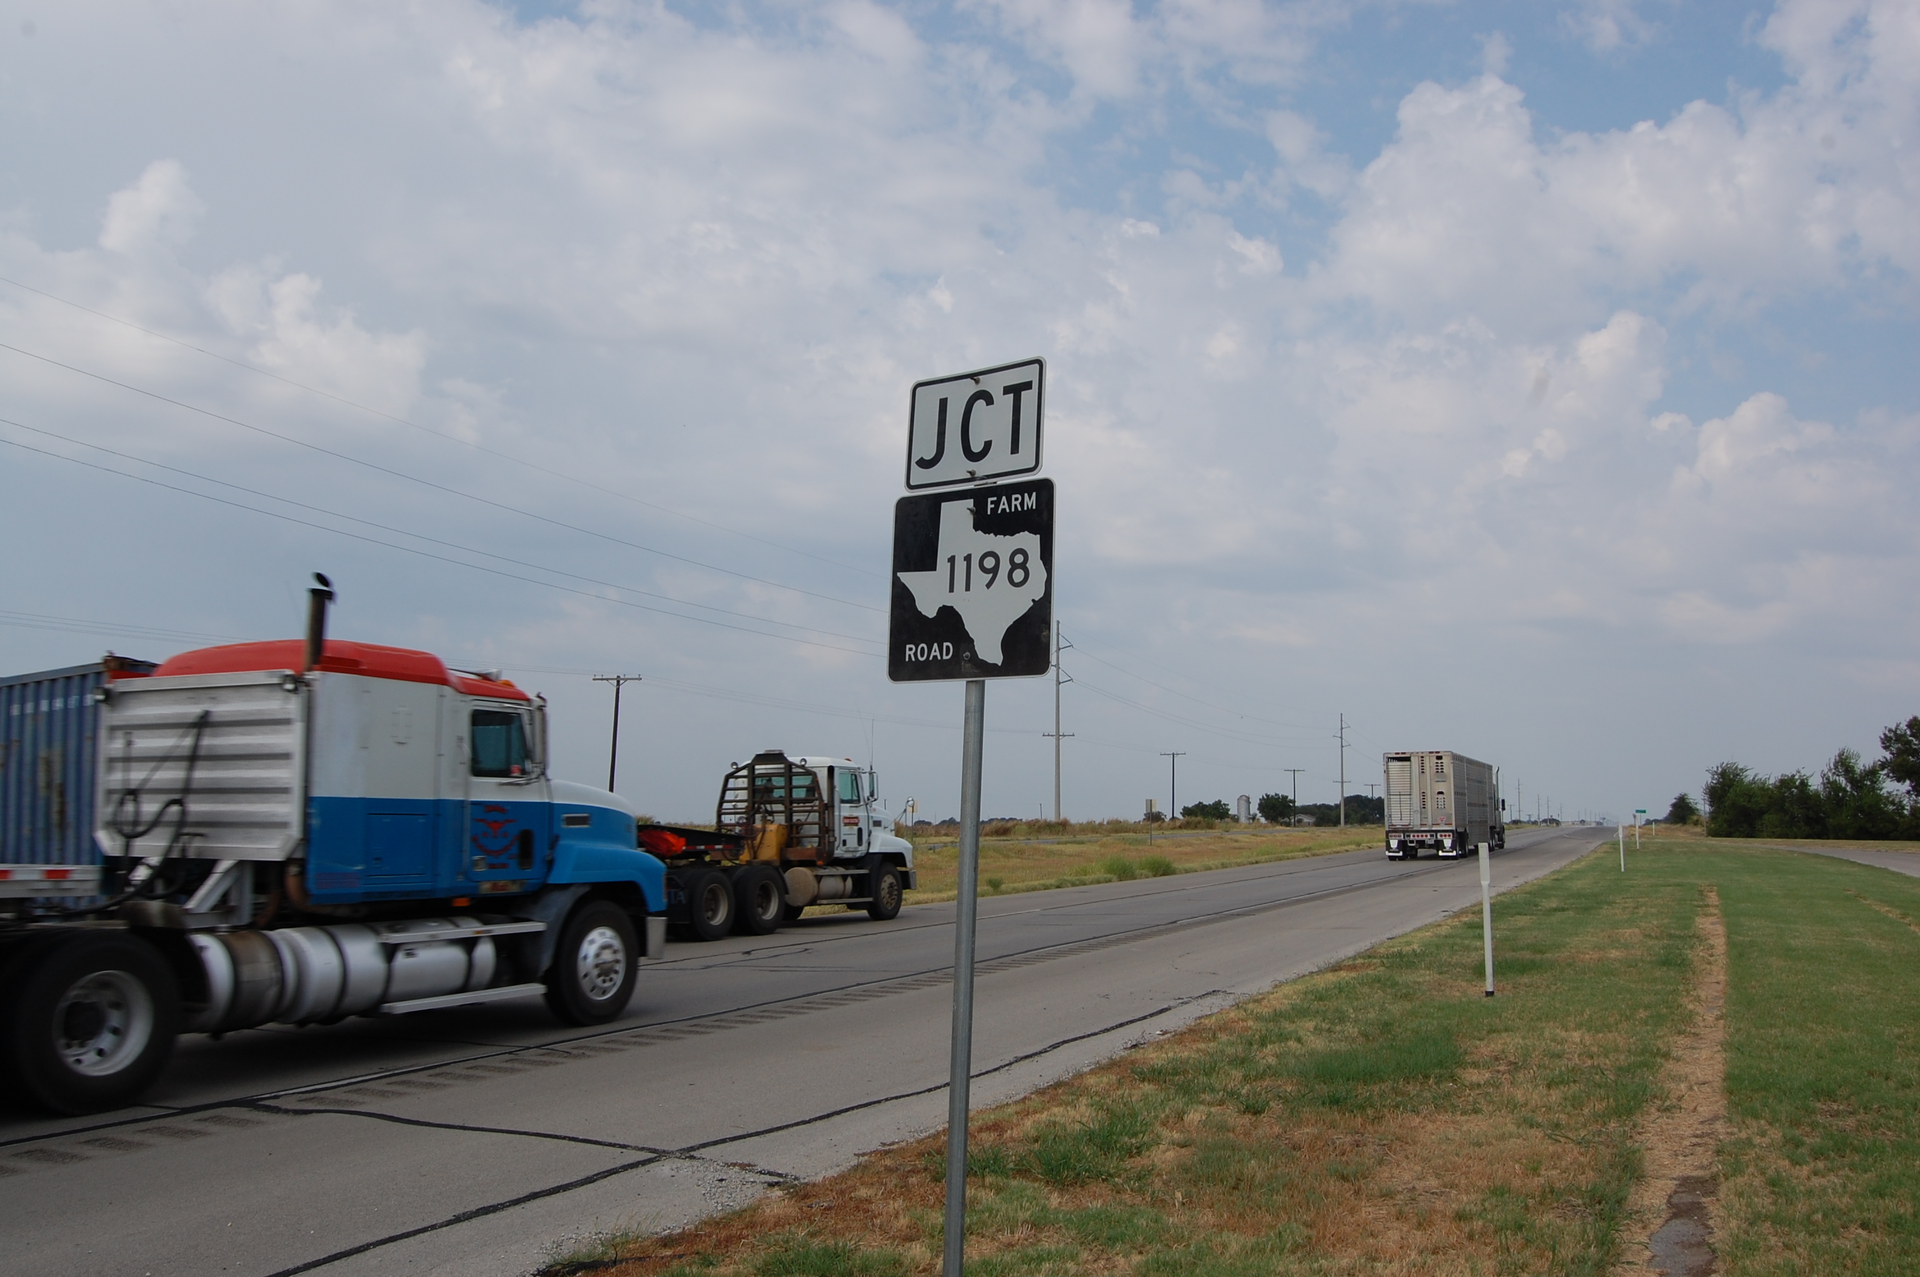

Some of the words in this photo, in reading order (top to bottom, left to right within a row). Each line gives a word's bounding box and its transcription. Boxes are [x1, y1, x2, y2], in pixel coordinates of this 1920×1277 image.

[914, 379, 1034, 470] JCT
[986, 492, 1037, 515] FARM
[946, 547, 1031, 594] 1198
[905, 642, 954, 662] ROAD
